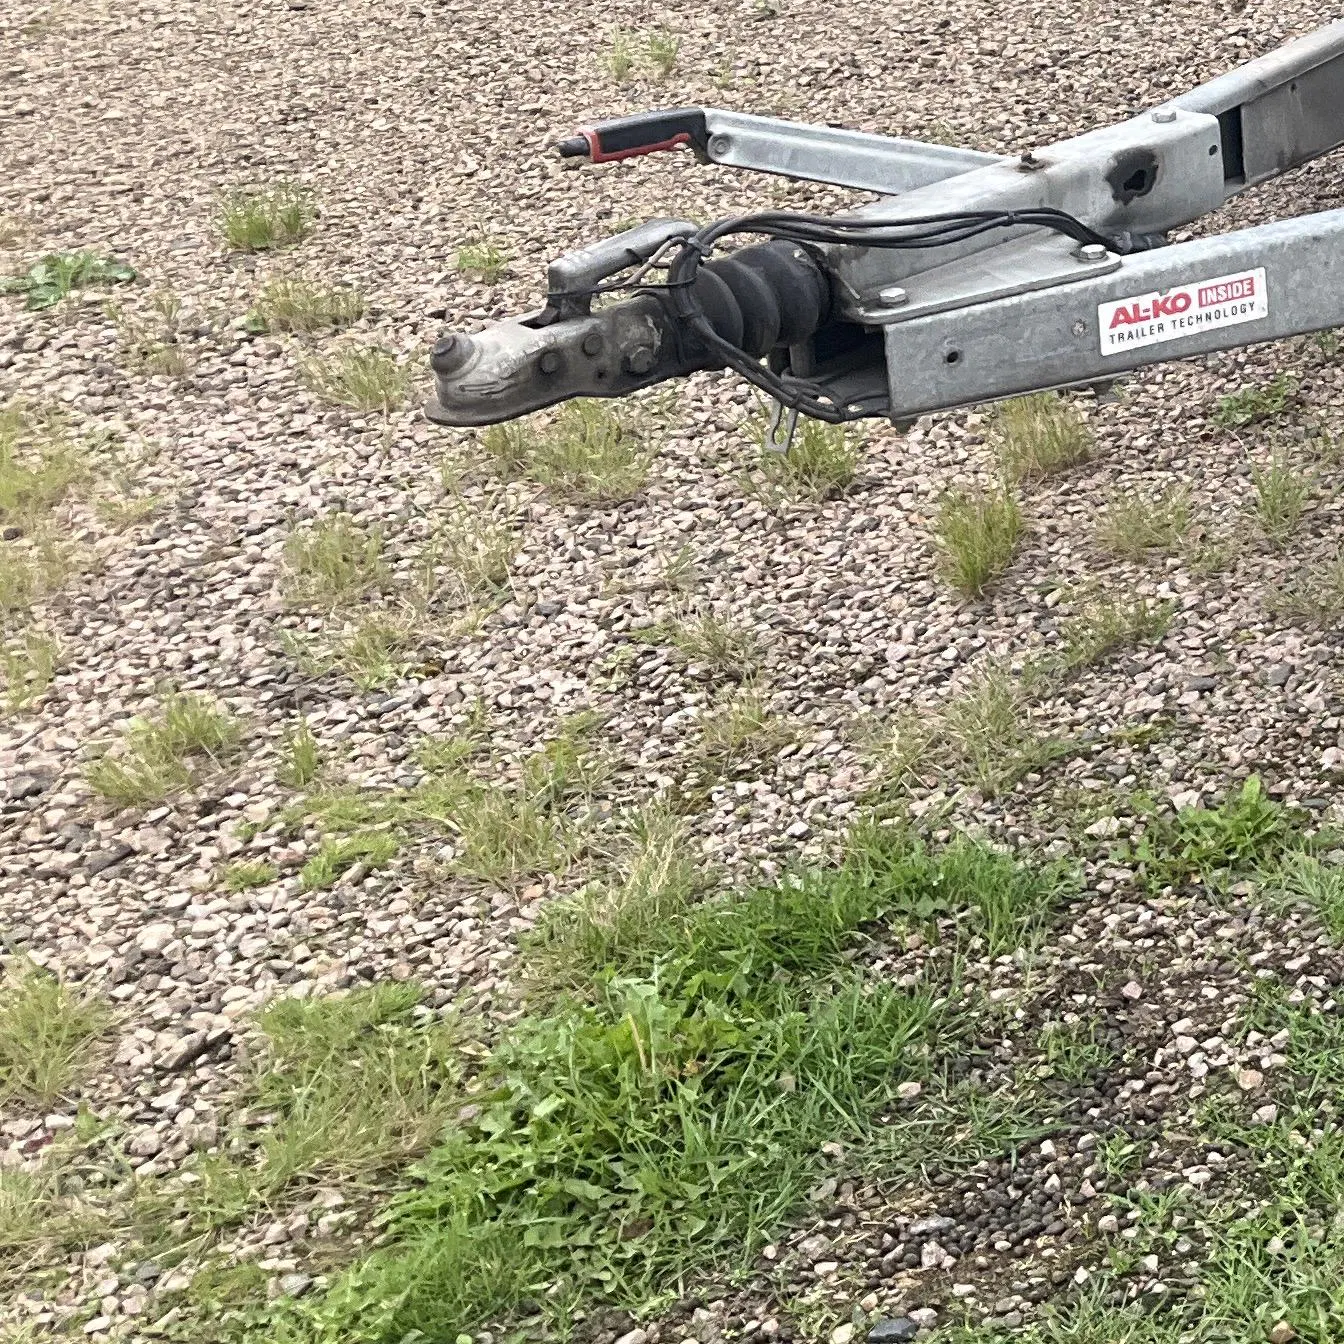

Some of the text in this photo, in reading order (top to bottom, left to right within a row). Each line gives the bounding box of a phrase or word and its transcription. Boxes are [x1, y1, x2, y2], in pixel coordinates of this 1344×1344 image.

[1109, 278, 1255, 330] AL-KO INSIDE
[1109, 301, 1256, 345] TRAILER TECHNOLOGY
